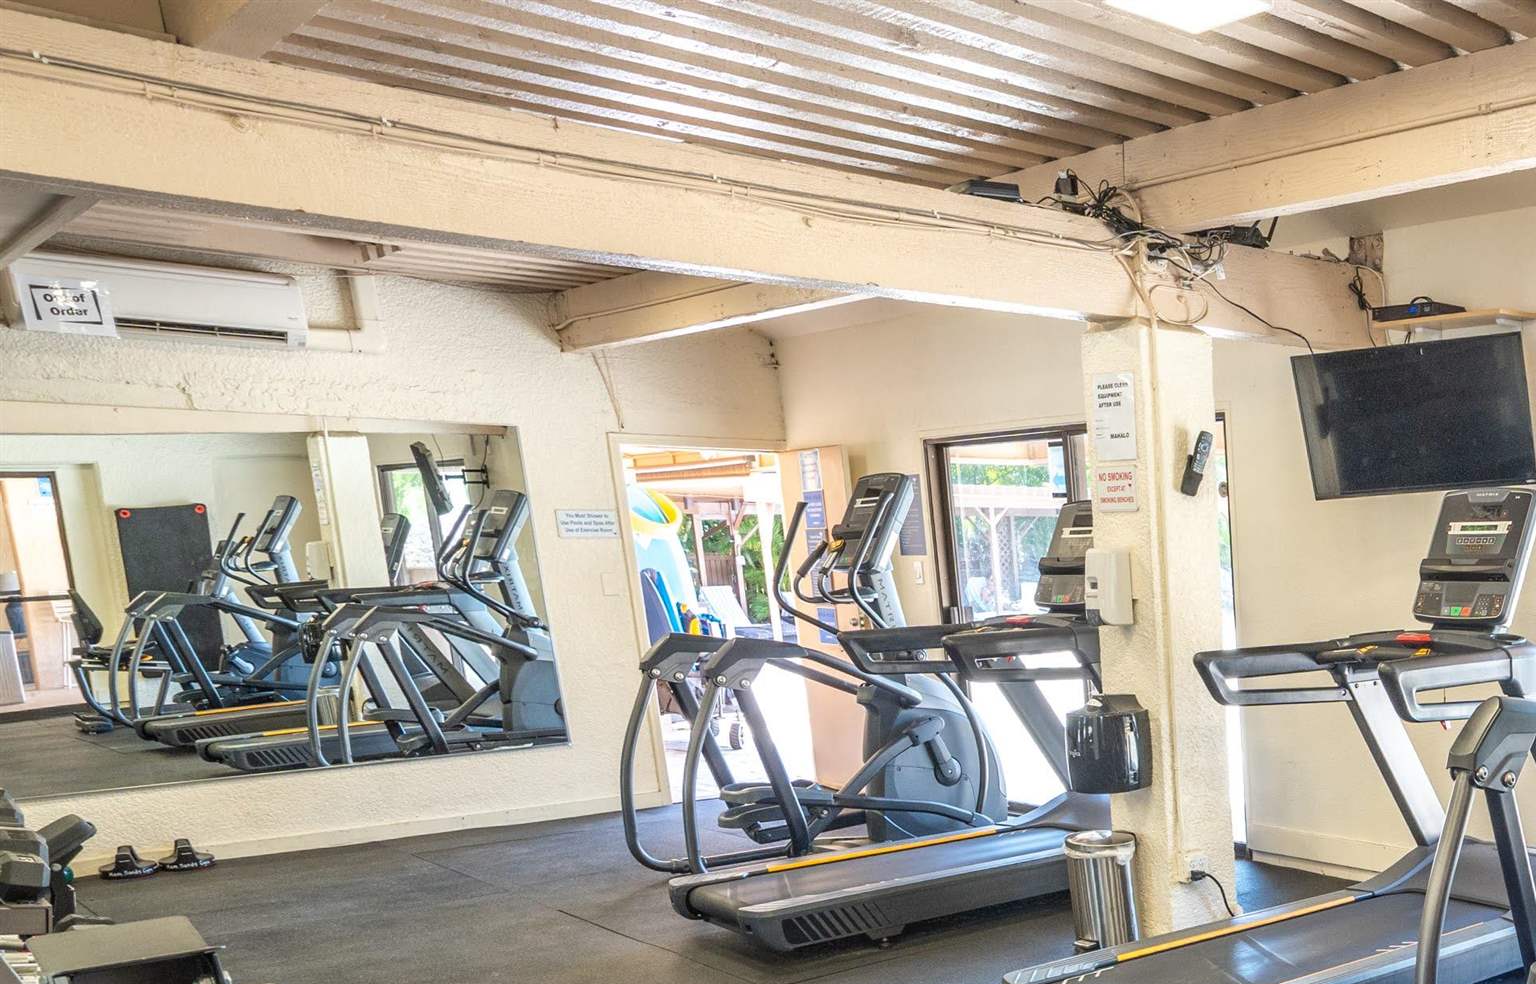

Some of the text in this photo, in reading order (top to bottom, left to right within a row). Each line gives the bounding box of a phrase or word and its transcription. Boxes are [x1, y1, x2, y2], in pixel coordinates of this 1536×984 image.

[72, 293, 85, 302] of
[50, 307, 88, 316] Order
[1098, 471, 1132, 481] NO SMOKING
